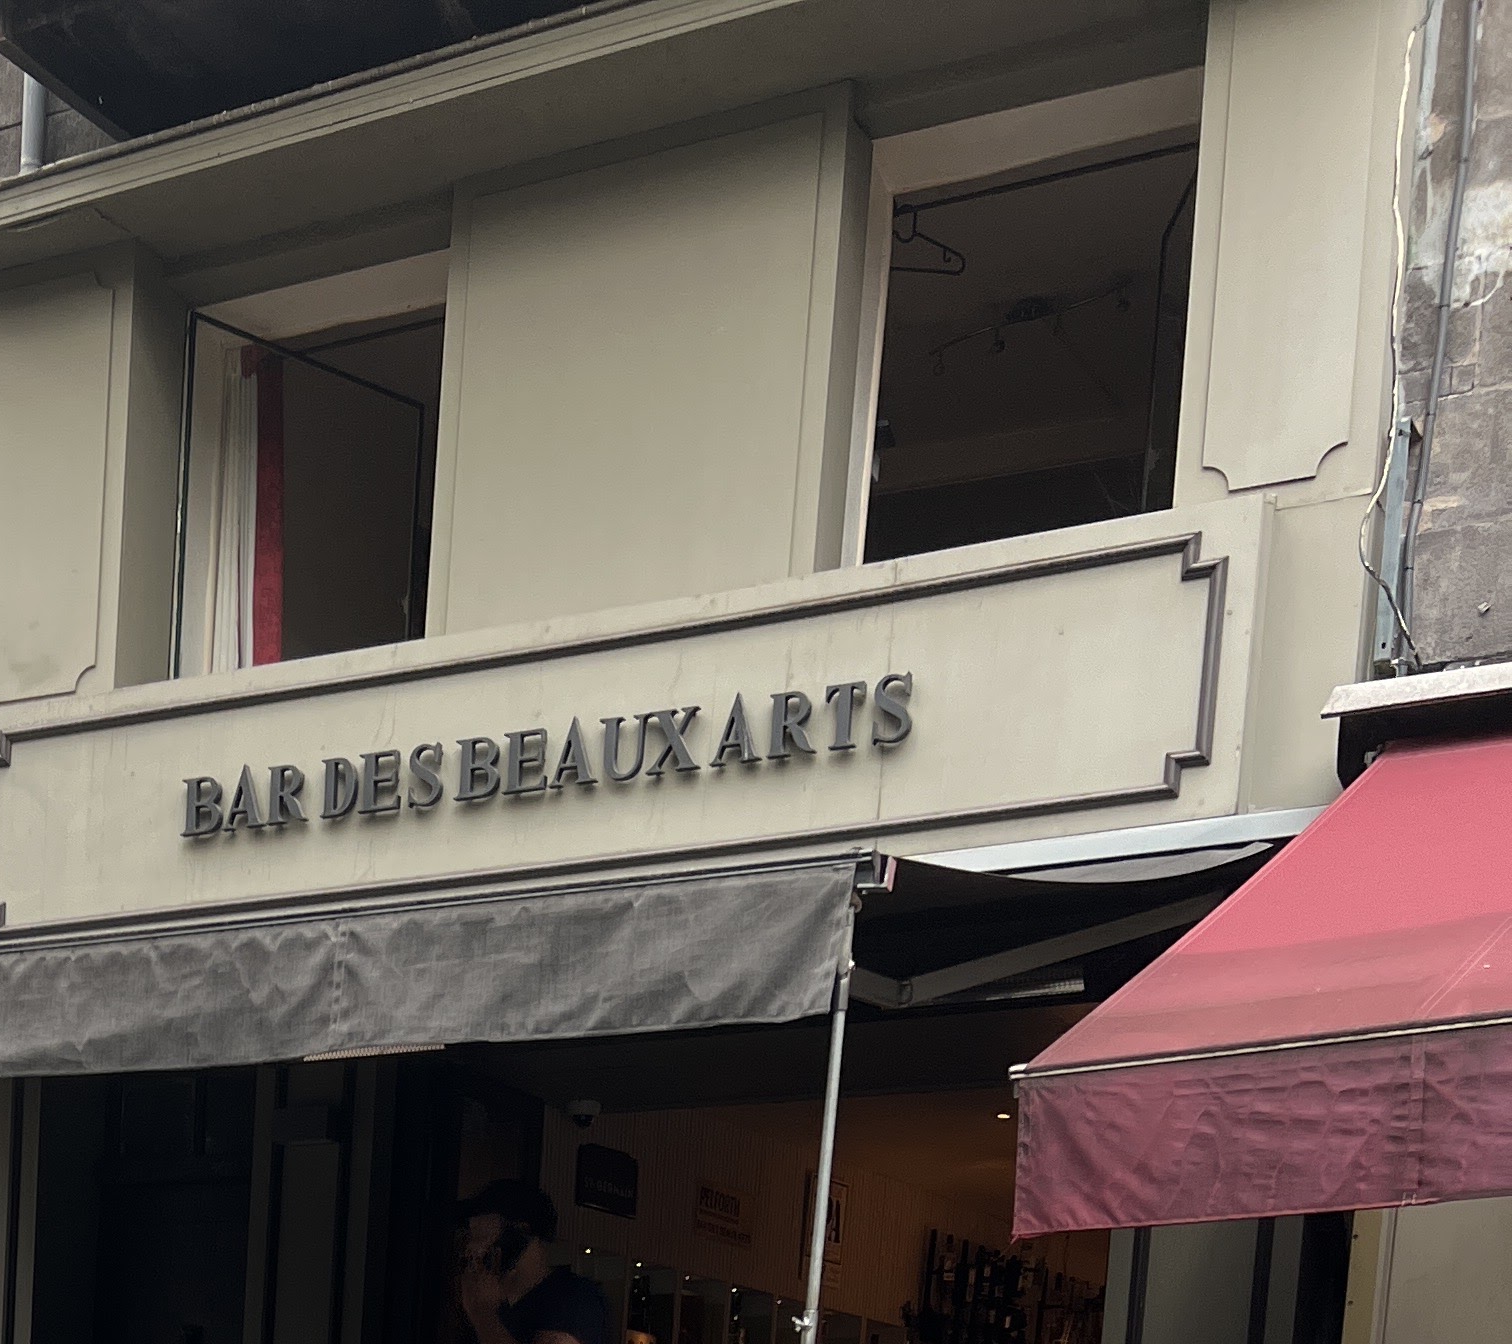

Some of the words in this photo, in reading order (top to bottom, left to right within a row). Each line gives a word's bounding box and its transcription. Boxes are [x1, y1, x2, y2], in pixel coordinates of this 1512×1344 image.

[181, 763, 309, 837] BAR
[320, 741, 444, 820] DES
[453, 705, 701, 802] BEAUX
[709, 671, 913, 768] ARTS
